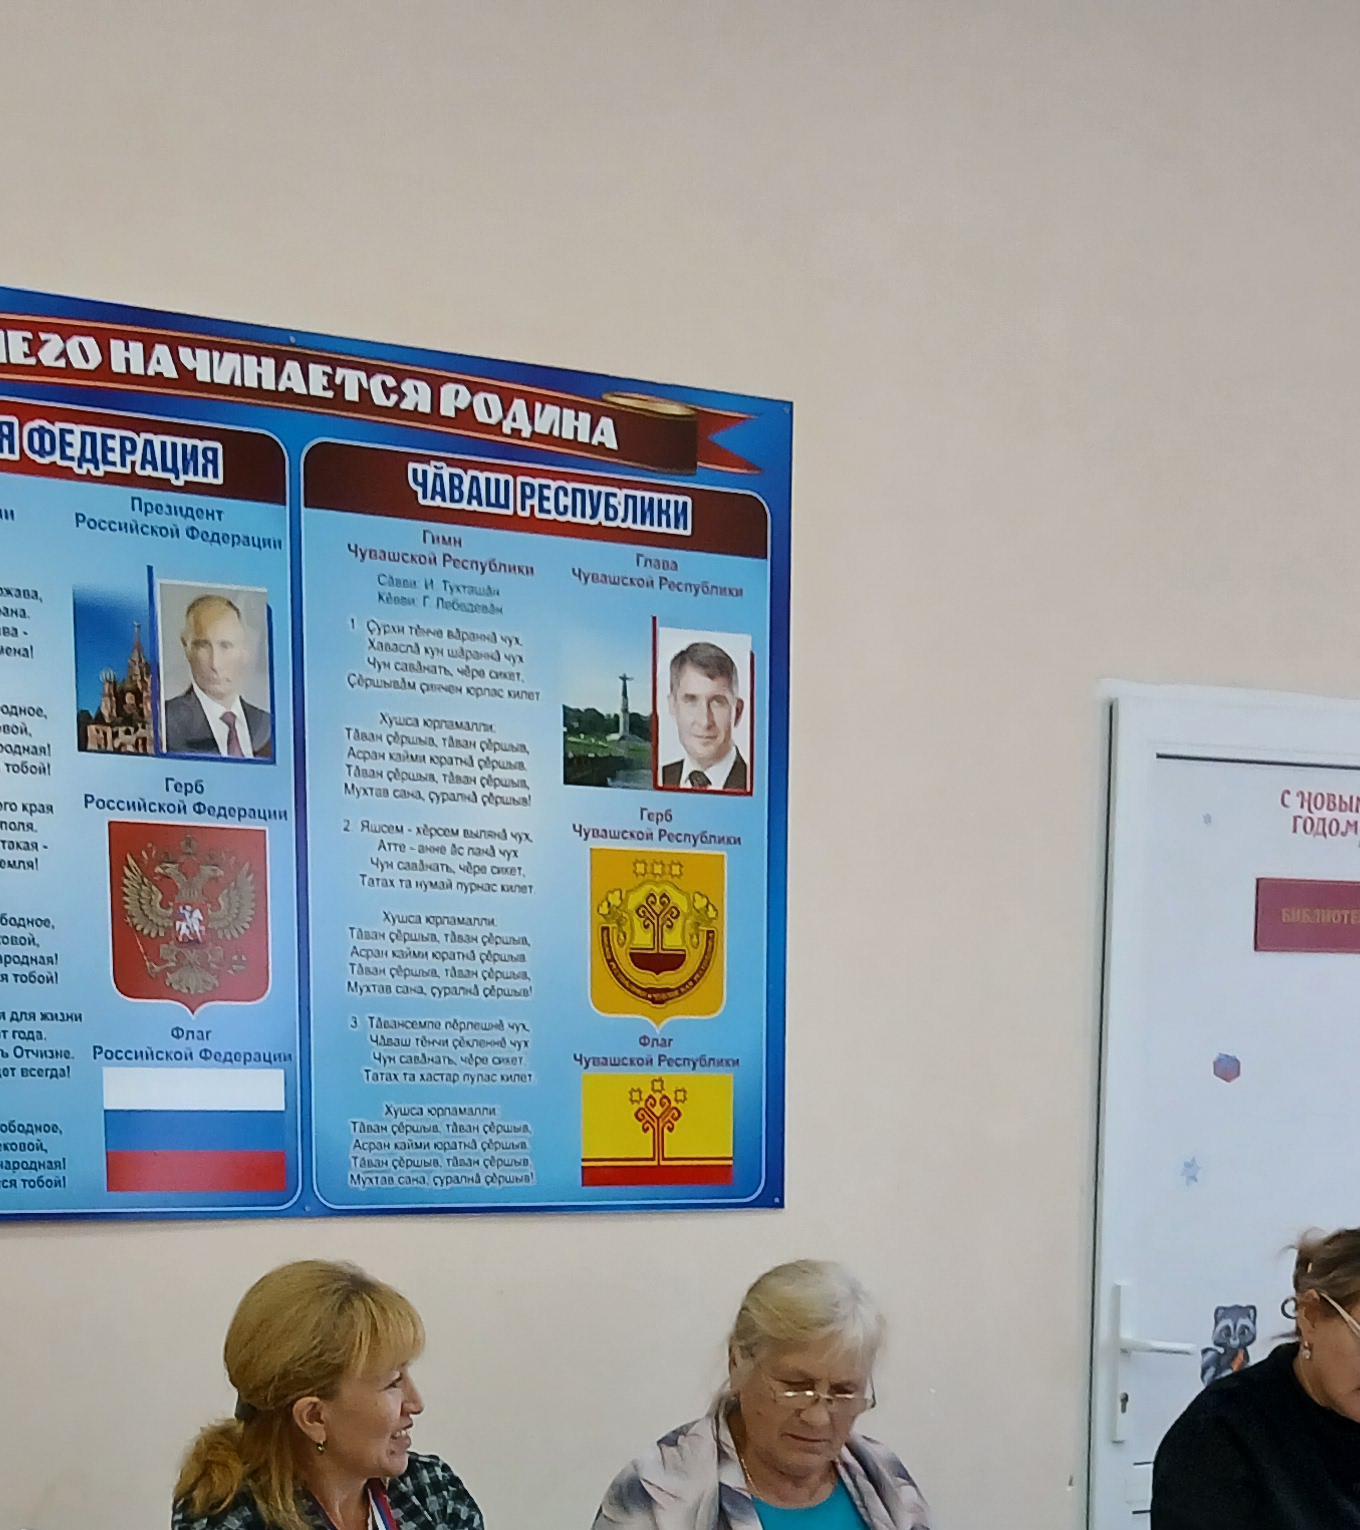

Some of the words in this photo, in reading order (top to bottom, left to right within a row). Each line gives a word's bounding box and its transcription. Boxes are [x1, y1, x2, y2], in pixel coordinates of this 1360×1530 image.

[111, 342, 432, 412] НАЧИНАЕТСЯ
[440, 383, 619, 451] РОДИНА
[25, 419, 222, 482] ФЕДЕРАЦИЯ
[129, 494, 224, 522] Президент
[518, 479, 691, 533] РЕСПУБЛИКИ
[73, 510, 180, 539] Российской
[184, 524, 282, 551] Федерации
[421, 528, 463, 549] Гимн
[346, 541, 438, 567] Чувашской
[441, 551, 535, 576] Республики
[634, 551, 679, 572] Глава
[570, 566, 655, 589] Чувашской
[657, 574, 743, 598] Республики
[164, 775, 205, 798] Герб
[20, 801, 54, 817] края
[82, 792, 188, 815] Российской
[191, 800, 288, 822] Федерации
[1280, 788, 1292, 810] С
[638, 805, 673, 826] Герб
[571, 822, 654, 842] Чувашской
[656, 827, 742, 847] Республики
[8, 1009, 37, 1023] для
[38, 1010, 82, 1023] жизни
[169, 1024, 212, 1042] Флаг
[637, 1033, 674, 1049] Флаг
[91, 1044, 194, 1062] Российской
[197, 1046, 293, 1067] Федерации
[571, 1051, 654, 1070] Чувашской
[656, 1052, 740, 1071] Республики
[19, 1063, 71, 1080] всегда!
[19, 1173, 67, 1189] тобой!
